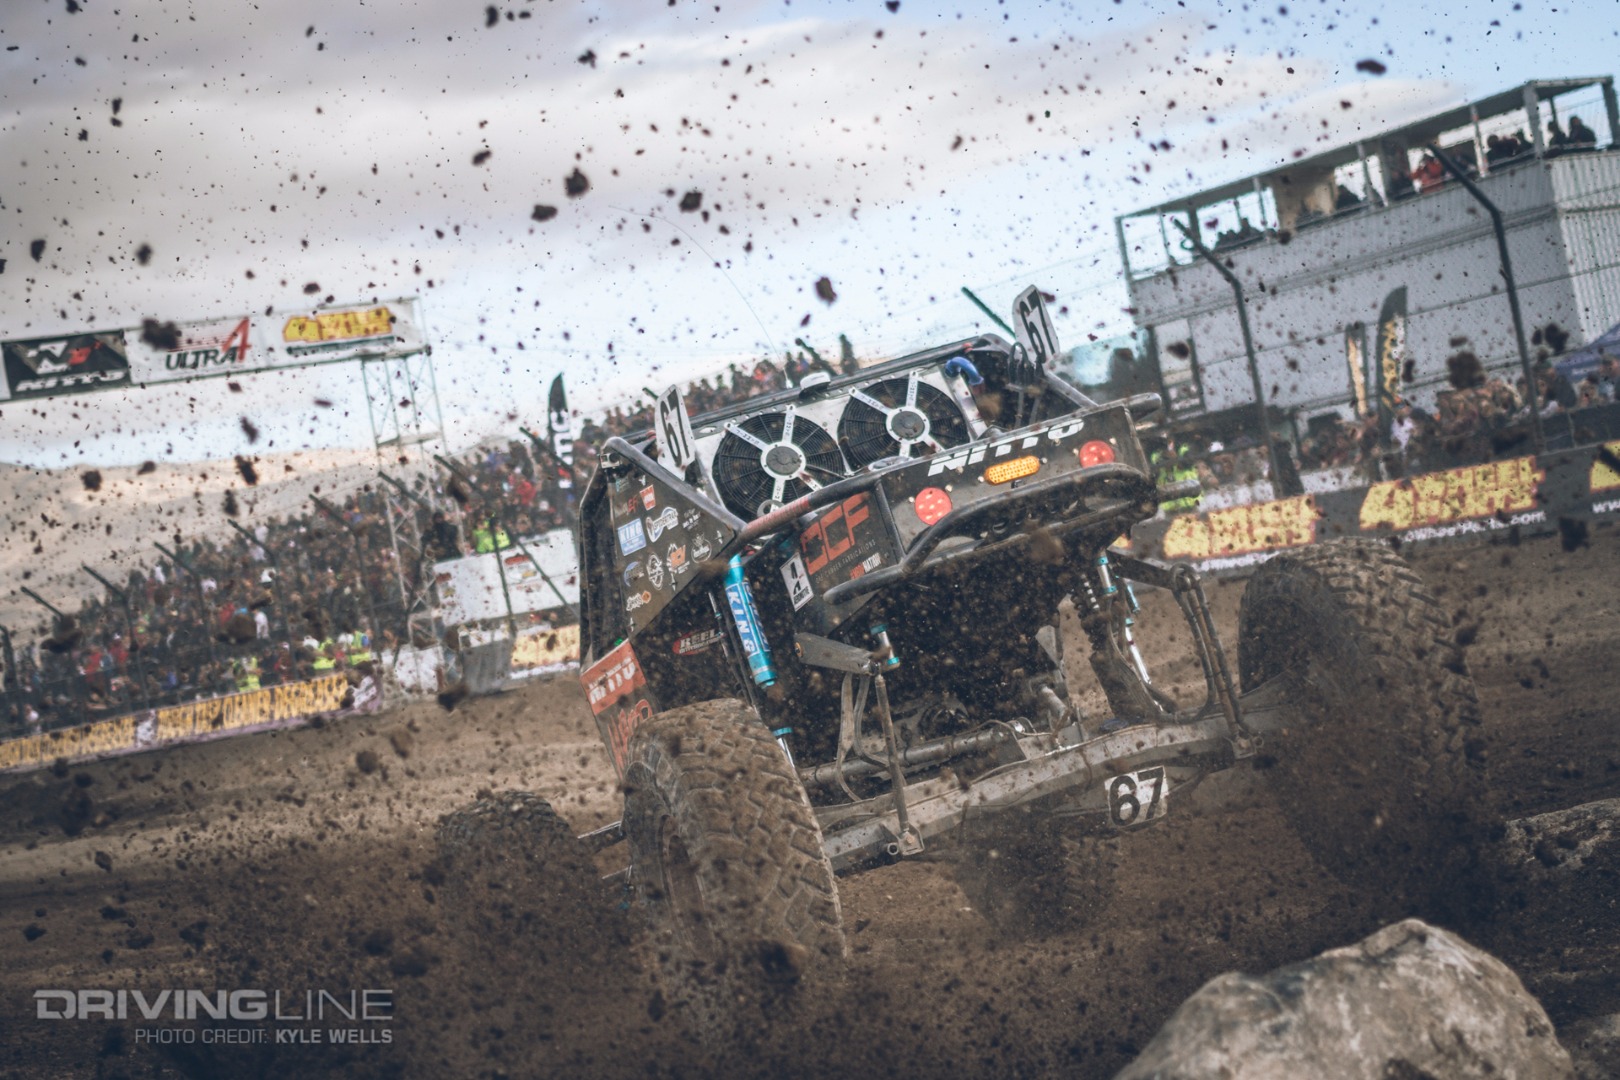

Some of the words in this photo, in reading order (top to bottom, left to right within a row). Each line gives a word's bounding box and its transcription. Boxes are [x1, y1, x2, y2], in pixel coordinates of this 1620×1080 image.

[1018, 288, 1056, 364] 67
[660, 388, 690, 468] 67
[927, 418, 1085, 477] NITTO
[617, 520, 644, 543] KING
[727, 591, 758, 653] KING
[1109, 767, 1164, 827] 67
